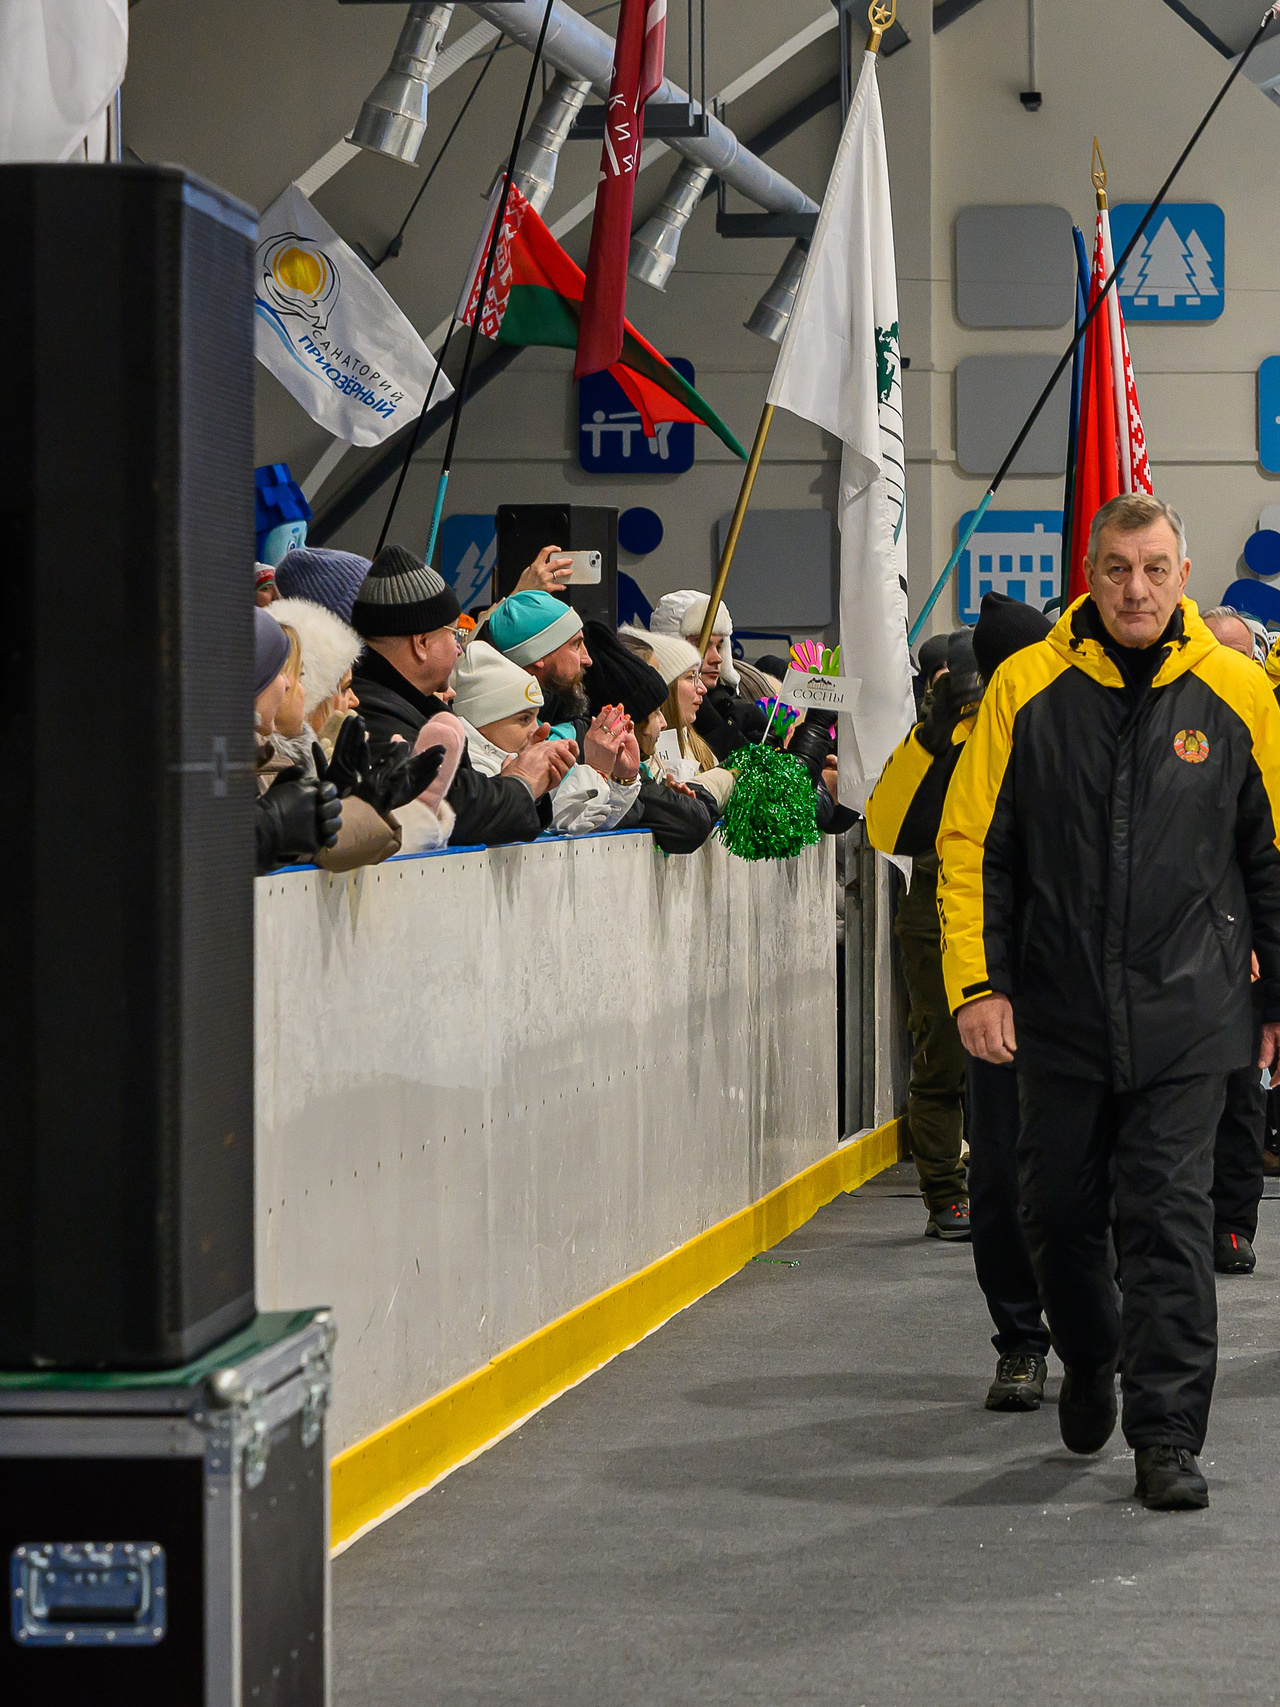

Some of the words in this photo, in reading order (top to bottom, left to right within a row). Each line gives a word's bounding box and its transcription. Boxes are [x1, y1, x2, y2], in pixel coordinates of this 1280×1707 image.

[298, 334, 398, 420] ПРИОЗЁРНЫЙ
[312, 329, 405, 403] САНАТОРИЙ
[792, 687, 845, 705] СОСНЫ
